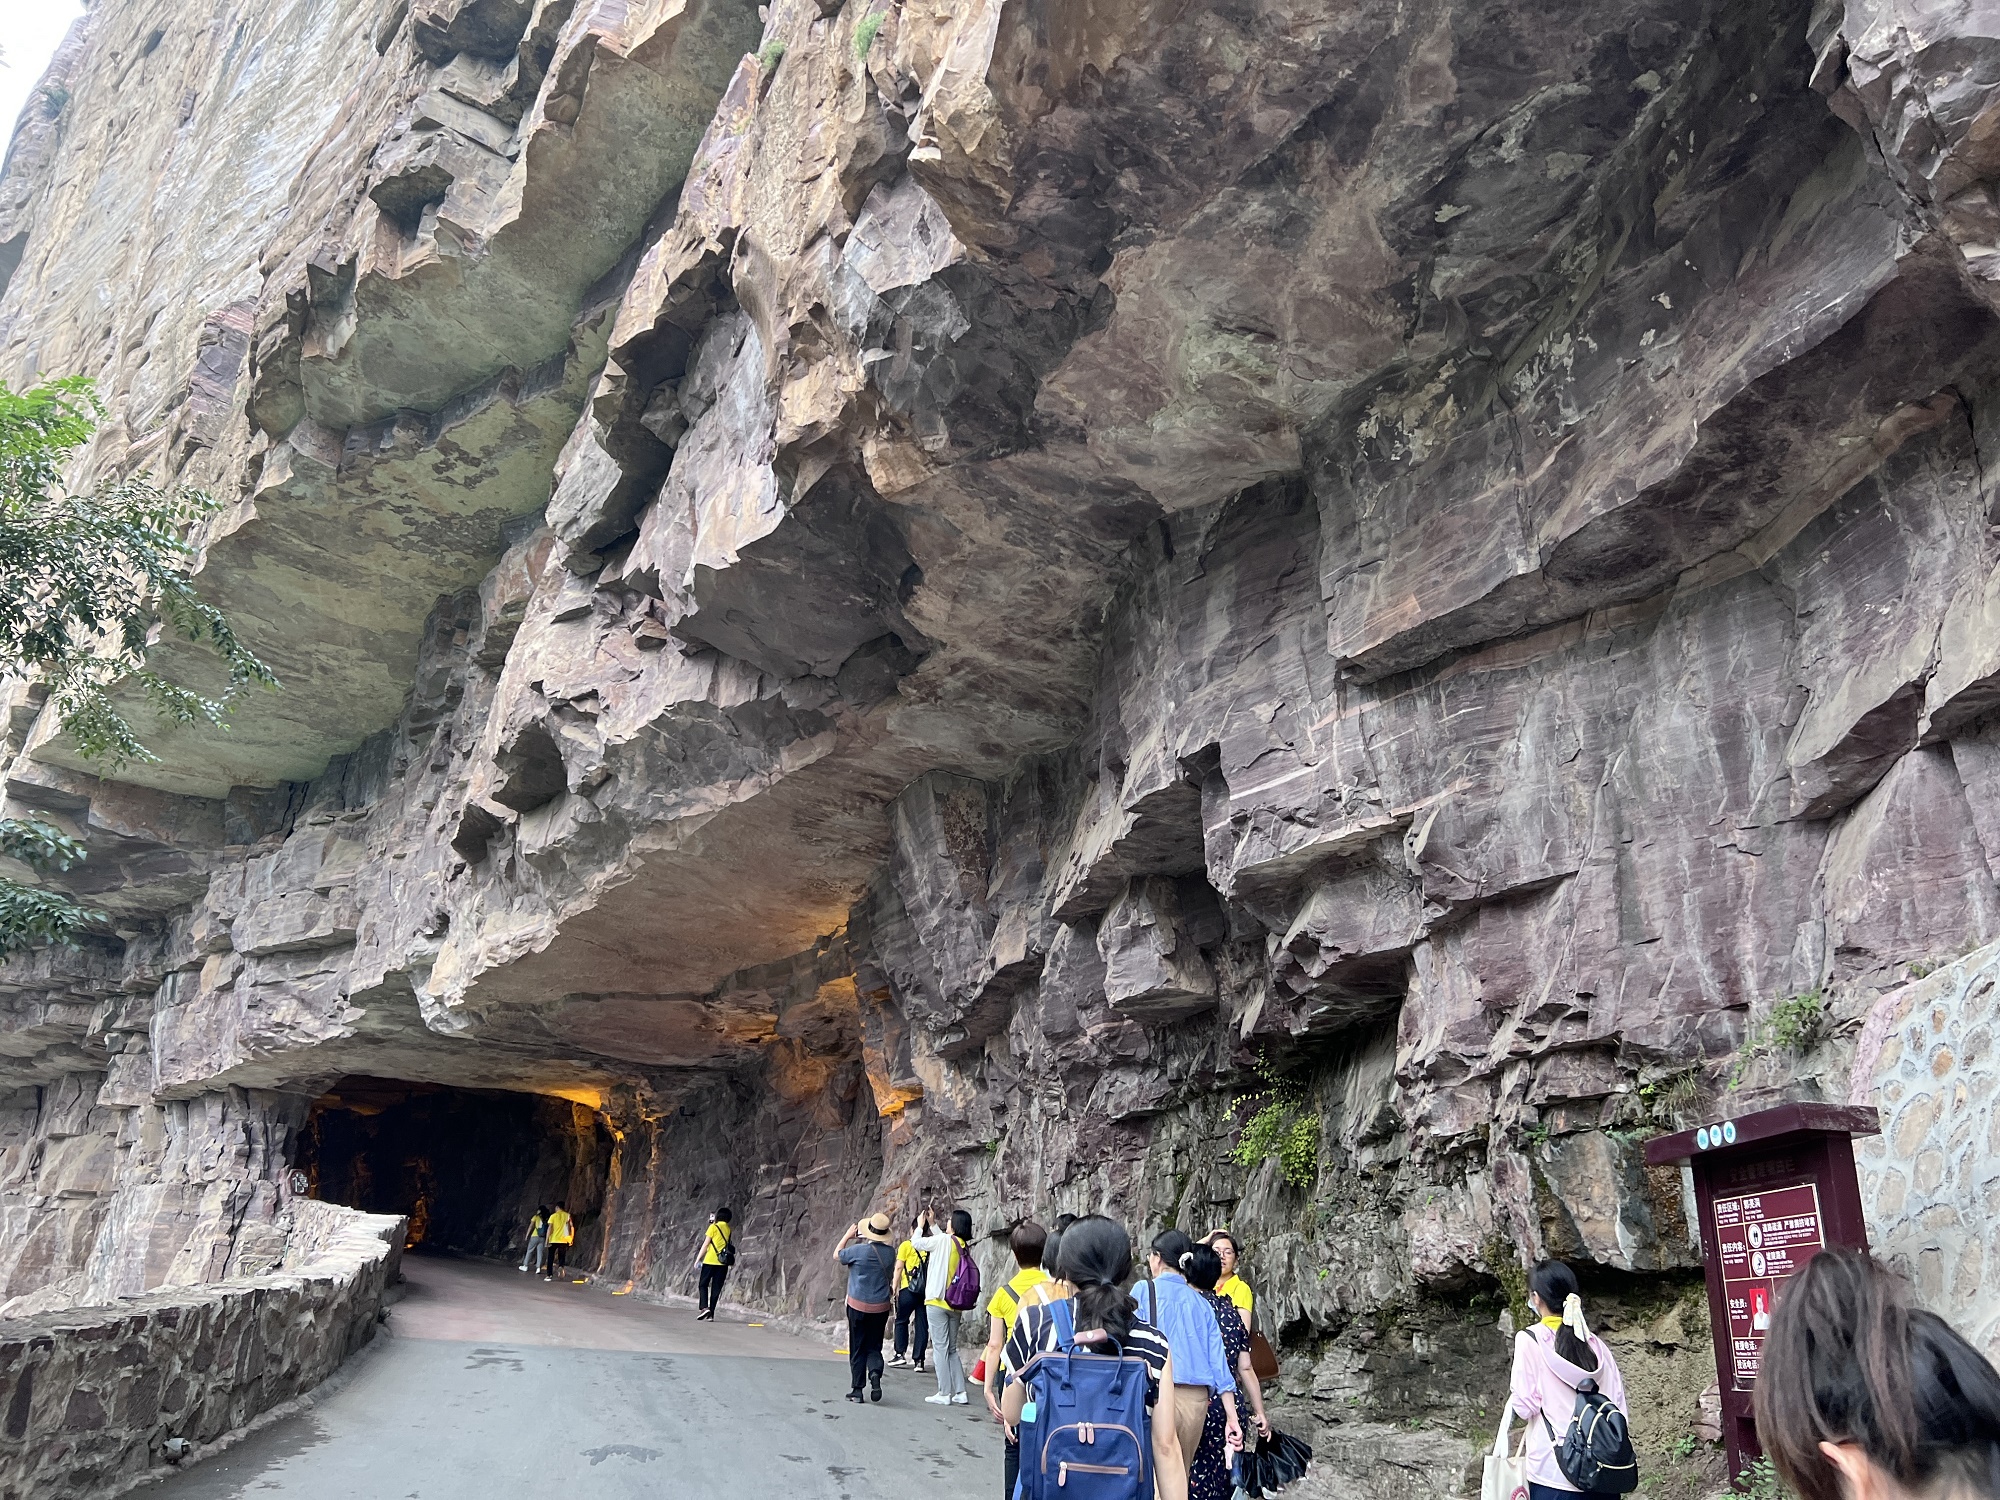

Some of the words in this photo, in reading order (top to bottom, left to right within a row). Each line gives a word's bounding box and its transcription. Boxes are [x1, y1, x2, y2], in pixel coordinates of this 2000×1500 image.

[1721, 1241, 1746, 1254] 责任内容：
[1729, 1298, 1748, 1309] 安全员：
